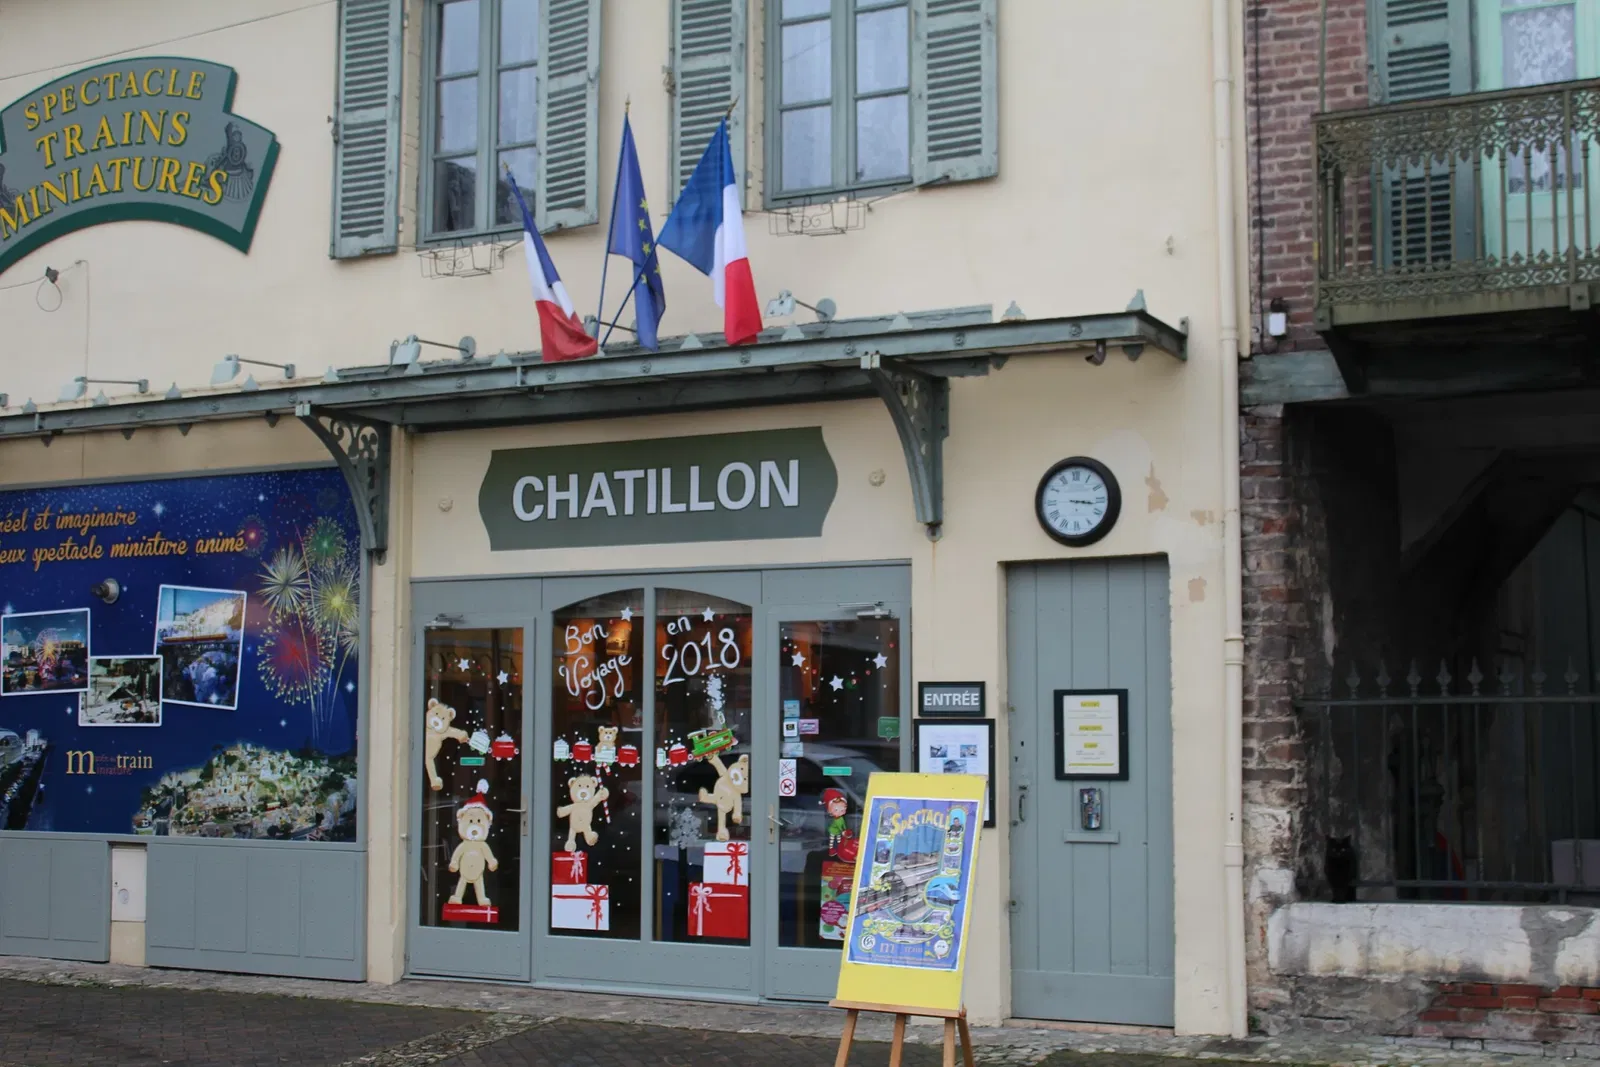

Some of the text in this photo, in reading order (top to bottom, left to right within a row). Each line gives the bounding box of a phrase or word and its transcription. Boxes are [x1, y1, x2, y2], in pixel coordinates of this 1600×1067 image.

[24, 68, 206, 131] SPECTACLE
[36, 109, 190, 169] TRAINS
[0, 156, 229, 240] MINIATURES
[512, 459, 799, 522] CHATILLON
[33, 505, 55, 531] et
[56, 505, 137, 536] imaginaire
[0, 547, 27, 563] eux
[32, 535, 104, 572] spectacle
[110, 531, 189, 558] miniature
[564, 624, 610, 655] Bon
[667, 616, 692, 635] en
[661, 627, 741, 687] 2018
[558, 654, 633, 710] Voyage
[923, 690, 980, 707] ENTRÉE
[116, 750, 153, 769] train
